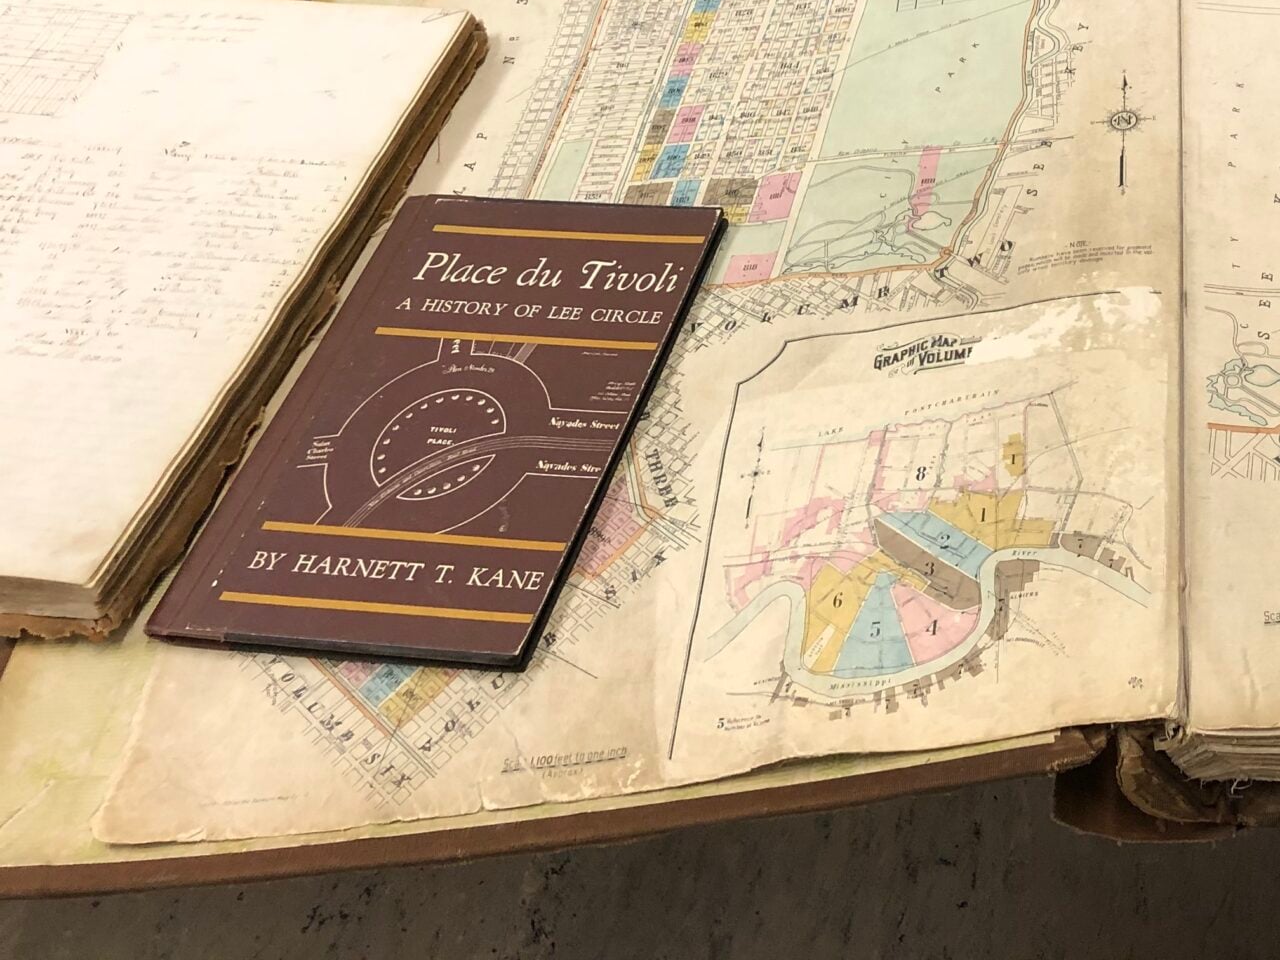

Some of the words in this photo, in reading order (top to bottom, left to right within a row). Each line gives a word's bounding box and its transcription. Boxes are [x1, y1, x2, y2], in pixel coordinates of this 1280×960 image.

[936, 240, 1013, 278] TWO
[412, 251, 503, 286] Place
[516, 258, 562, 289] du
[580, 259, 686, 295] Tivoli
[395, 296, 413, 312] A
[420, 297, 509, 319] HISTORY
[513, 302, 542, 320] OF
[547, 304, 583, 323] LEE
[589, 307, 664, 327] CIRCLE
[690, 286, 891, 335] VOLUME
[874, 340, 928, 371] GRAPHIC
[904, 390, 999, 415] PONTCHARTRAIN
[430, 426, 458, 434] TIVOLI
[590, 420, 621, 431] Street
[818, 426, 844, 437] LAKE
[648, 448, 678, 510] THREE
[916, 466, 927, 481] 8
[248, 550, 287, 575] BY
[292, 553, 423, 583] HARNETT
[435, 564, 456, 585] T.
[466, 567, 544, 593] KANE
[924, 561, 935, 577] 3
[831, 592, 844, 609] 6
[829, 678, 892, 691] Mississippi
